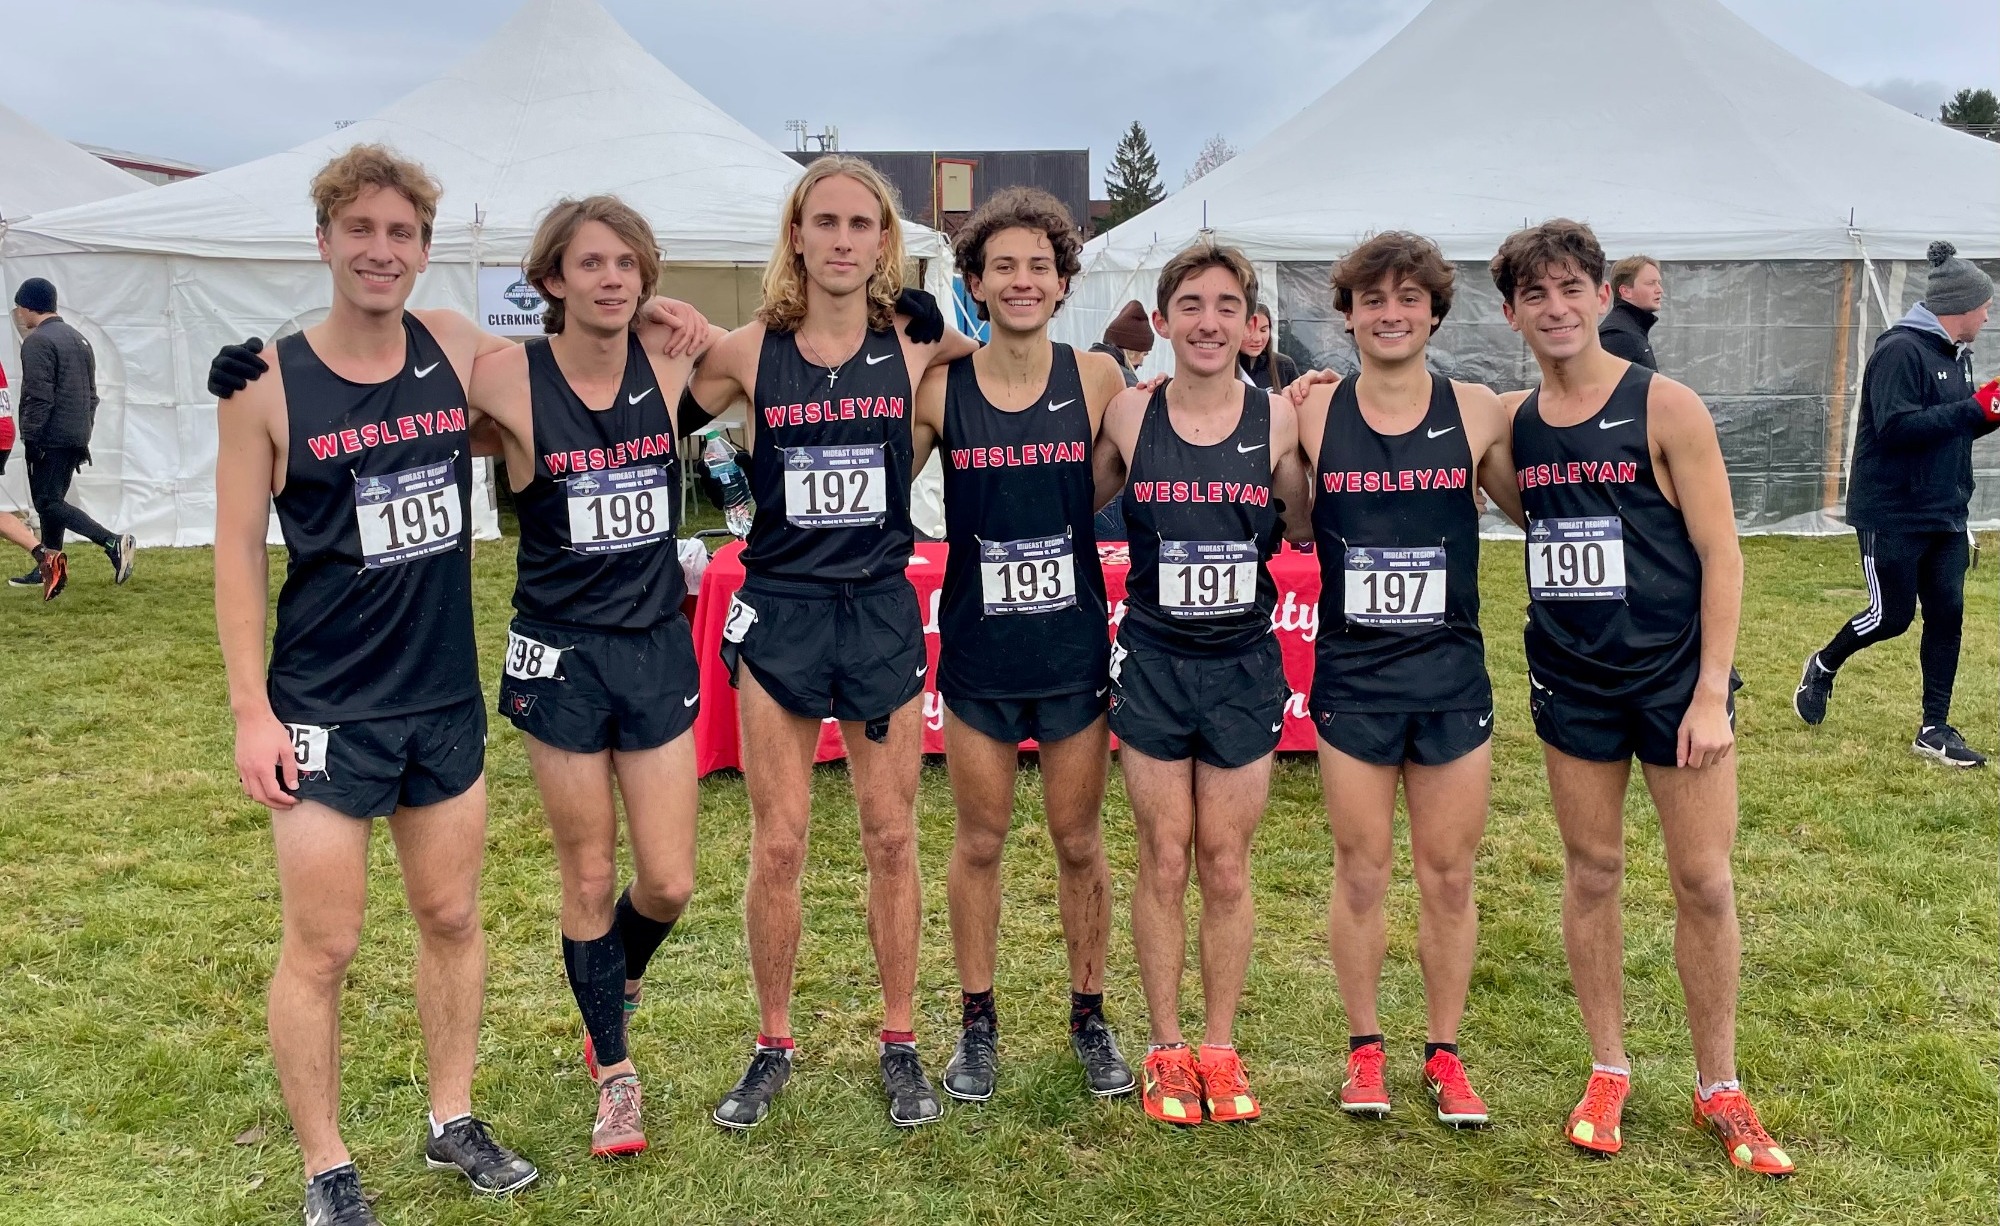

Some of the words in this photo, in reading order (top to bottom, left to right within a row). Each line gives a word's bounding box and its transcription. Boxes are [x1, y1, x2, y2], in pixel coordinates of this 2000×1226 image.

[488, 314, 540, 326] CLERKING
[764, 396, 904, 428] WESLEYAN
[308, 406, 466, 460] WESLEYAN
[544, 432, 670, 476] WESLEYAN
[822, 449, 851, 458] MIDEAST
[950, 442, 1086, 470] WESLEYAN
[398, 470, 426, 484] MIDEAST
[608, 472, 636, 482] MIDEAST
[1322, 466, 1467, 493] WESLEYAN
[1516, 460, 1637, 491] WESLEYAN
[801, 470, 870, 515] 192
[1134, 482, 1269, 507] WESLEYAN
[378, 490, 450, 551] 195
[586, 491, 655, 541] 198
[1558, 521, 1584, 530] MIDEAST
[1016, 542, 1043, 550] MIDEAST
[1540, 542, 1606, 587] 190
[996, 559, 1061, 602] 193
[1177, 564, 1239, 606] 191
[1362, 572, 1429, 614] 197
